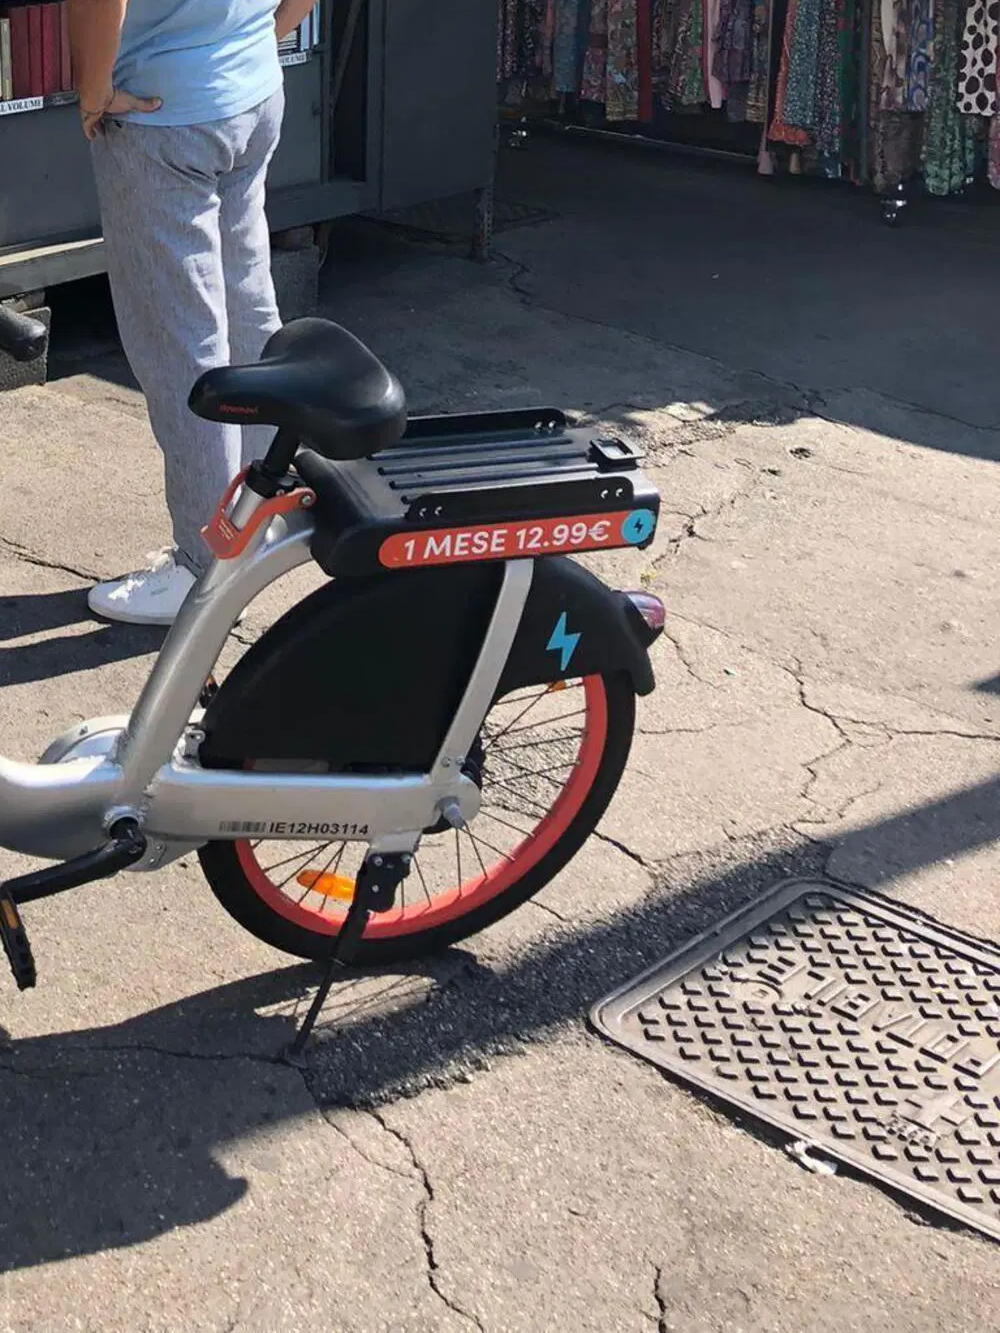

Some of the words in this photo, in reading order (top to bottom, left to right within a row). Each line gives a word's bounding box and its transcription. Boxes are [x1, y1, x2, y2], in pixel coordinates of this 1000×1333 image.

[404, 539, 415, 560] 1
[423, 530, 508, 559] MESE
[516, 521, 611, 550] 12.99€
[269, 821, 369, 835] IE12H03114
